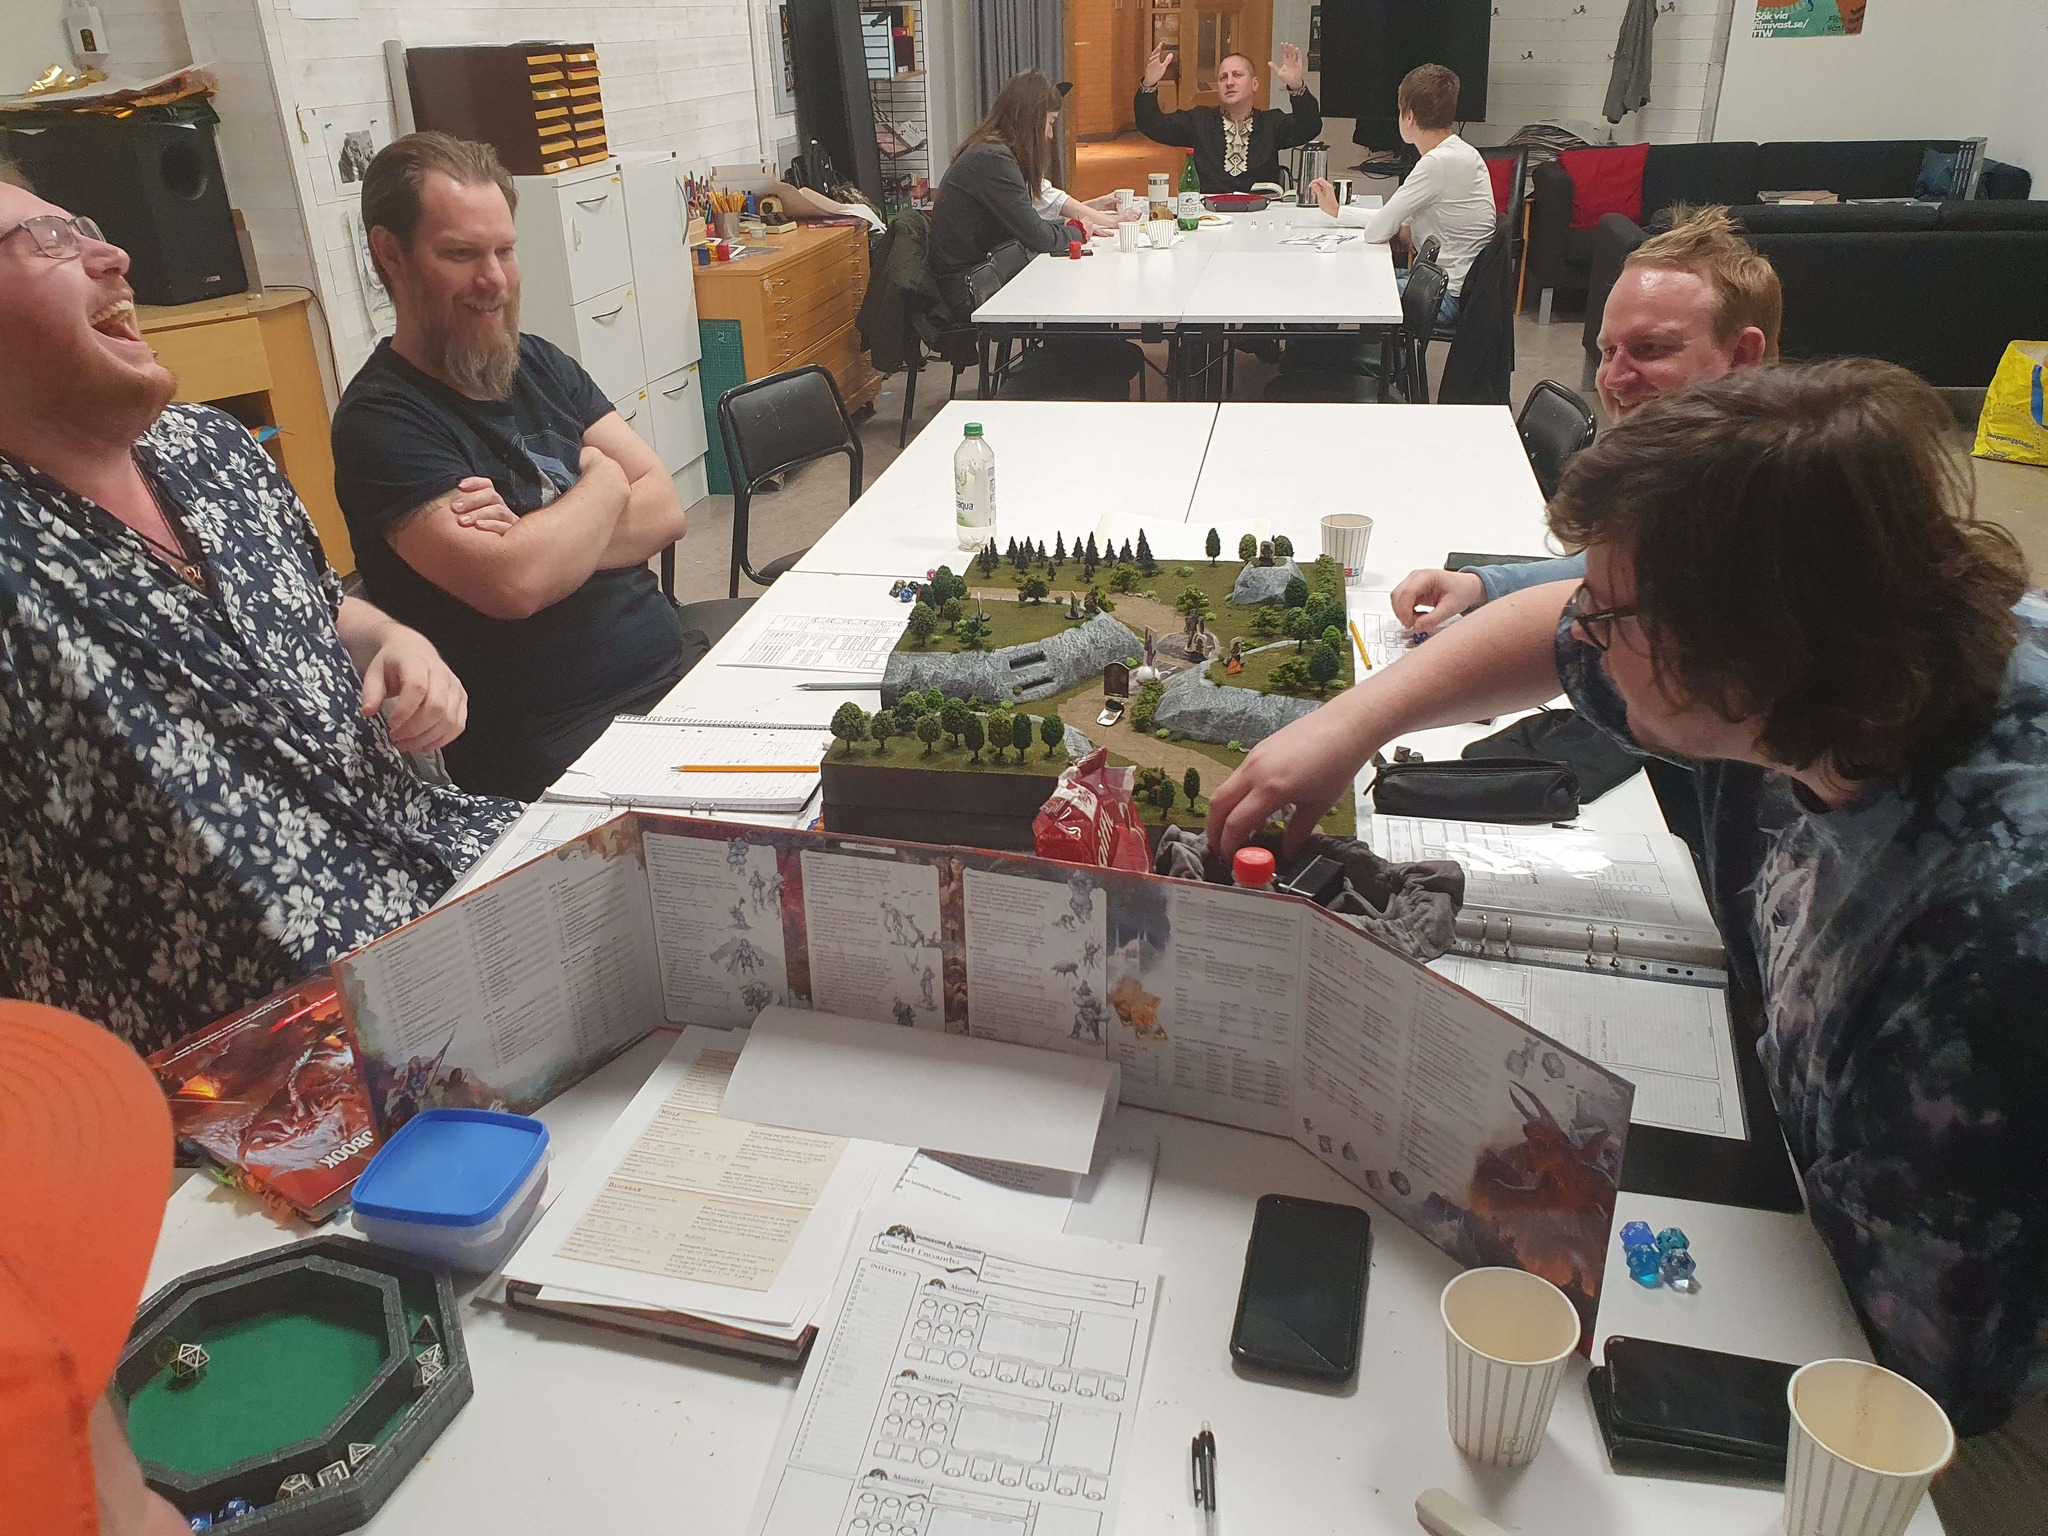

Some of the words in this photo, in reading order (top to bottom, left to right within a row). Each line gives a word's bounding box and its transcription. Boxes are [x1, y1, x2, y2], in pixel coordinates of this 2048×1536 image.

[1755, 11, 1773, 20] Sök
[1774, 11, 1788, 20] via
[1180, 206, 1198, 214] CIDER
[717, 331, 726, 344] A2
[881, 1240, 915, 1255] Combat
[917, 1249, 961, 1265] Encounter
[870, 1263, 908, 1277] INITIATIVE
[950, 1283, 980, 1295] Monster
[923, 1373, 954, 1385] Monster
[893, 1473, 925, 1485] Monster
